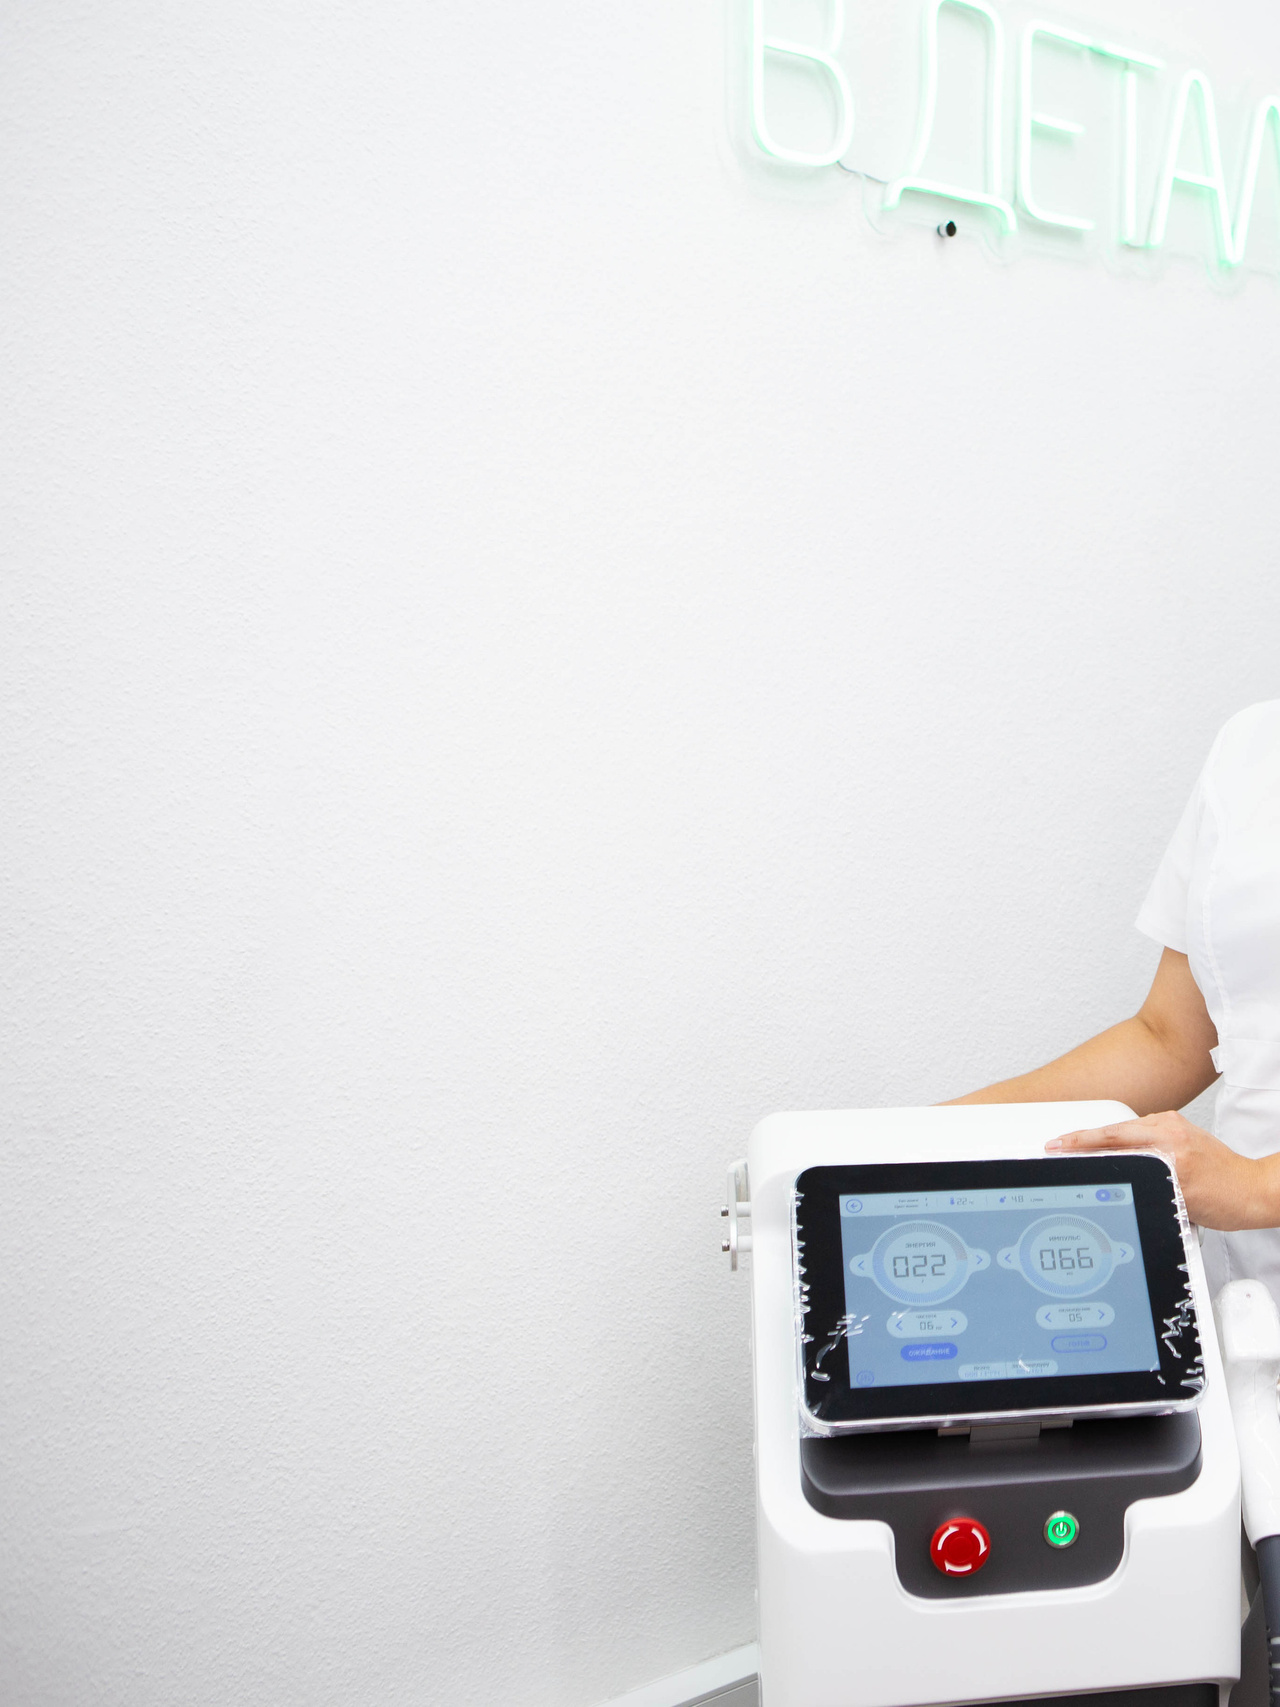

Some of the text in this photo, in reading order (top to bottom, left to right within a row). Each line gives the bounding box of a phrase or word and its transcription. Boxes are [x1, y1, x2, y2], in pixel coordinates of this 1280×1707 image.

[750, 0, 853, 167] В
[893, 1254, 946, 1278] 022
[1040, 1247, 1094, 1271] 066
[919, 1321, 934, 1331] 06
[908, 1347, 951, 1358] ОЖИДАНИЕ
